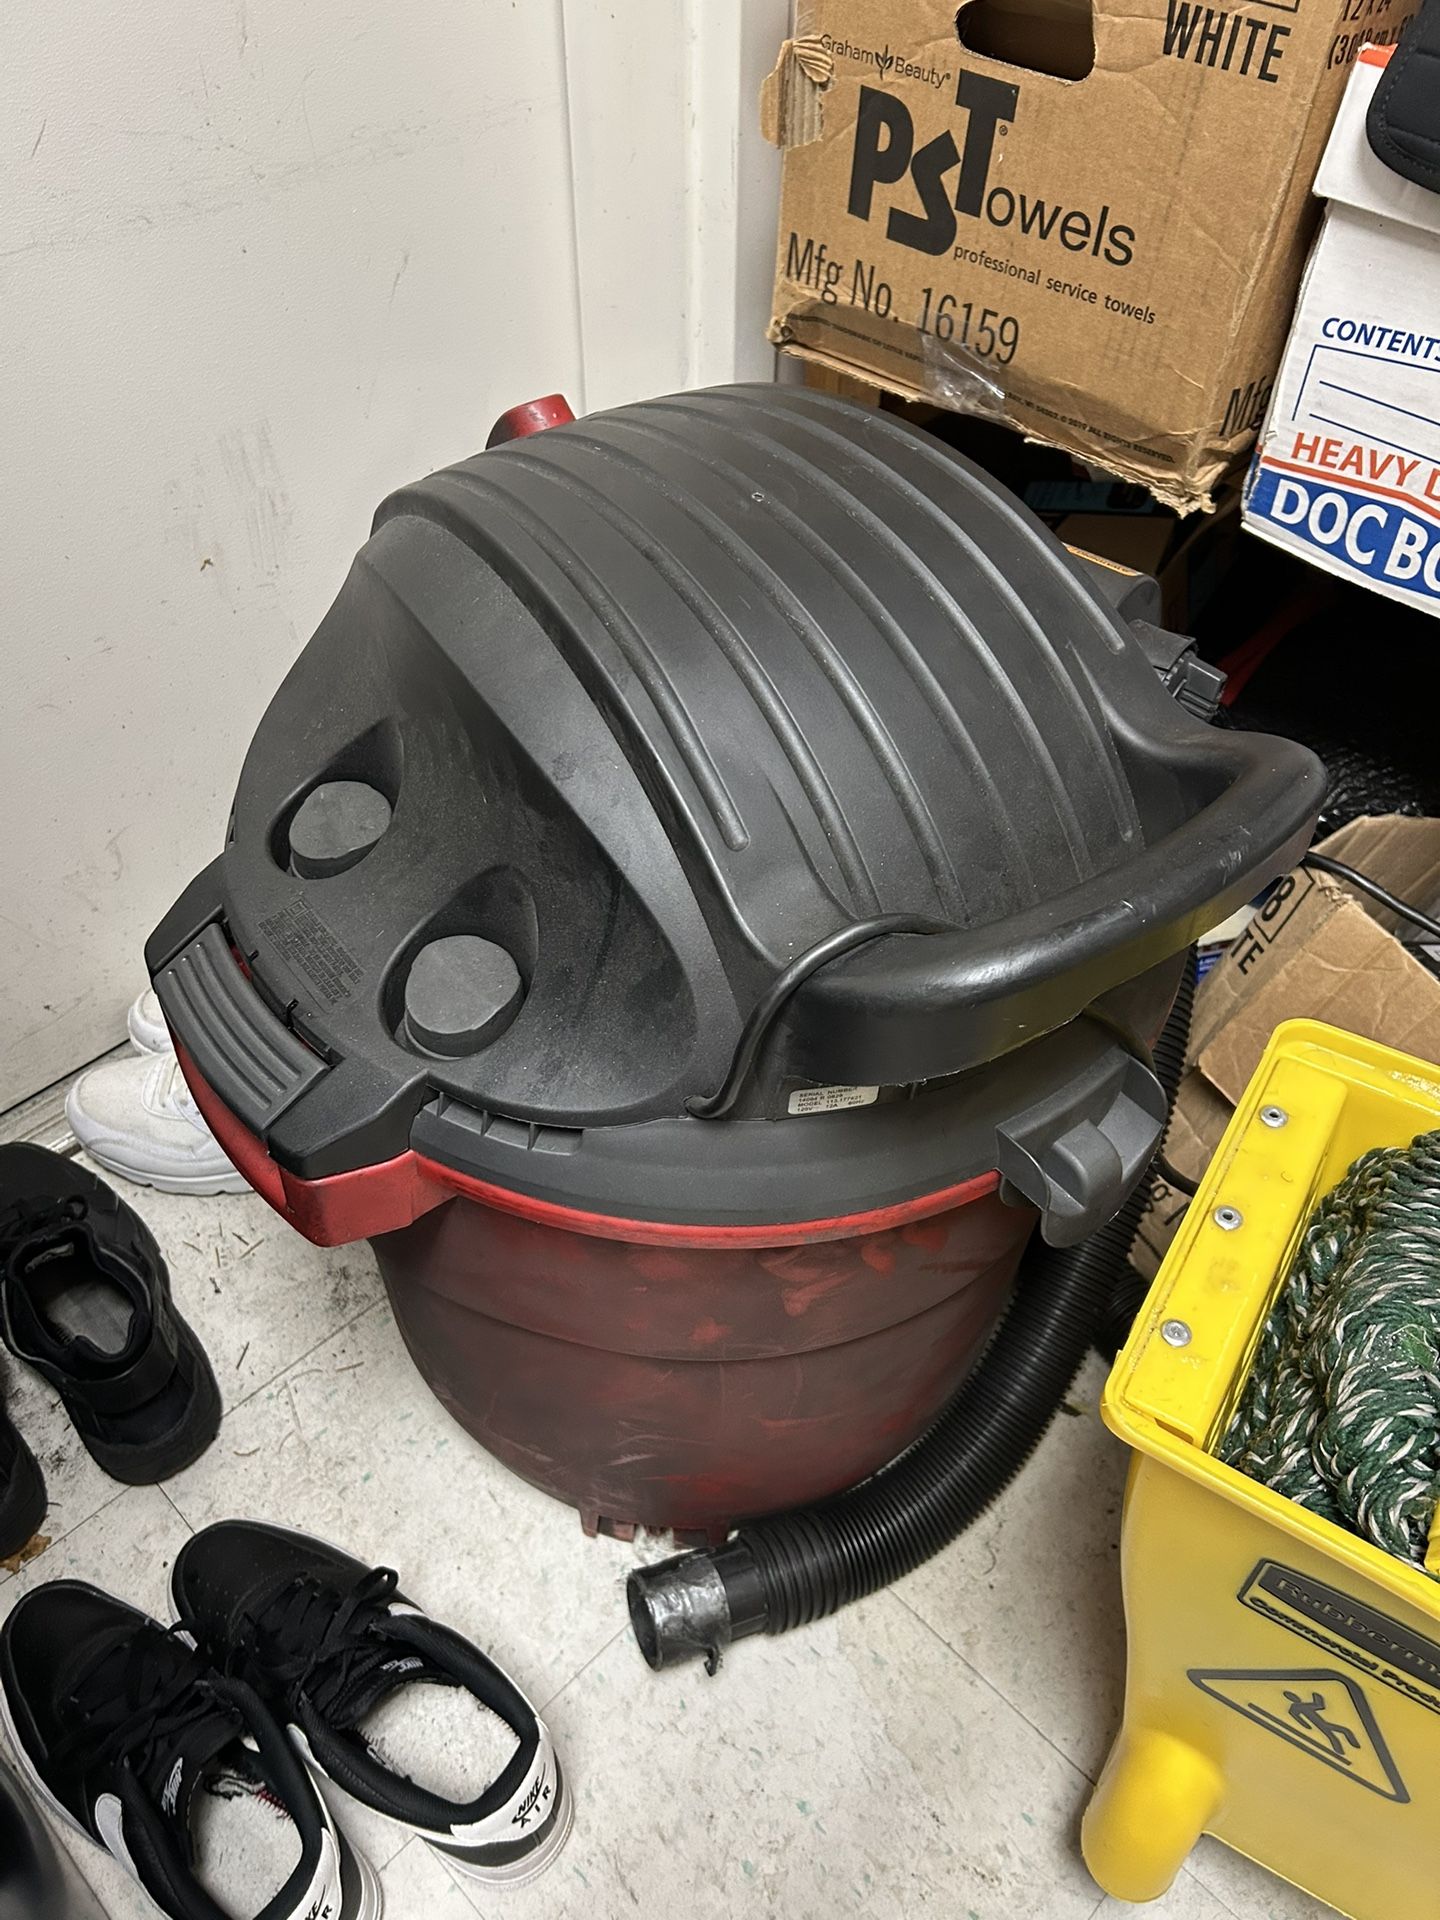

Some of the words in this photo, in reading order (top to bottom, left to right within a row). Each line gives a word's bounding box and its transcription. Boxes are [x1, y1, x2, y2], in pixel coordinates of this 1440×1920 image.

[820, 34, 874, 65] Graham
[1162, 0, 1291, 83] WHITE
[786, 232, 843, 306] Mfg
[851, 259, 899, 323] No.
[917, 288, 1020, 364] 16159
[953, 246, 1041, 285] professional
[1046, 277, 1097, 304] service
[1104, 295, 1156, 324] towels
[1291, 432, 1421, 486] HEAVY
[1270, 479, 1388, 565] DOC
[1249, 1597, 1379, 1671] Commercial
[1276, 1578, 1440, 1677] Rubberm
[517, 1775, 541, 1815] NIKE
[520, 1785, 551, 1828] AIR
